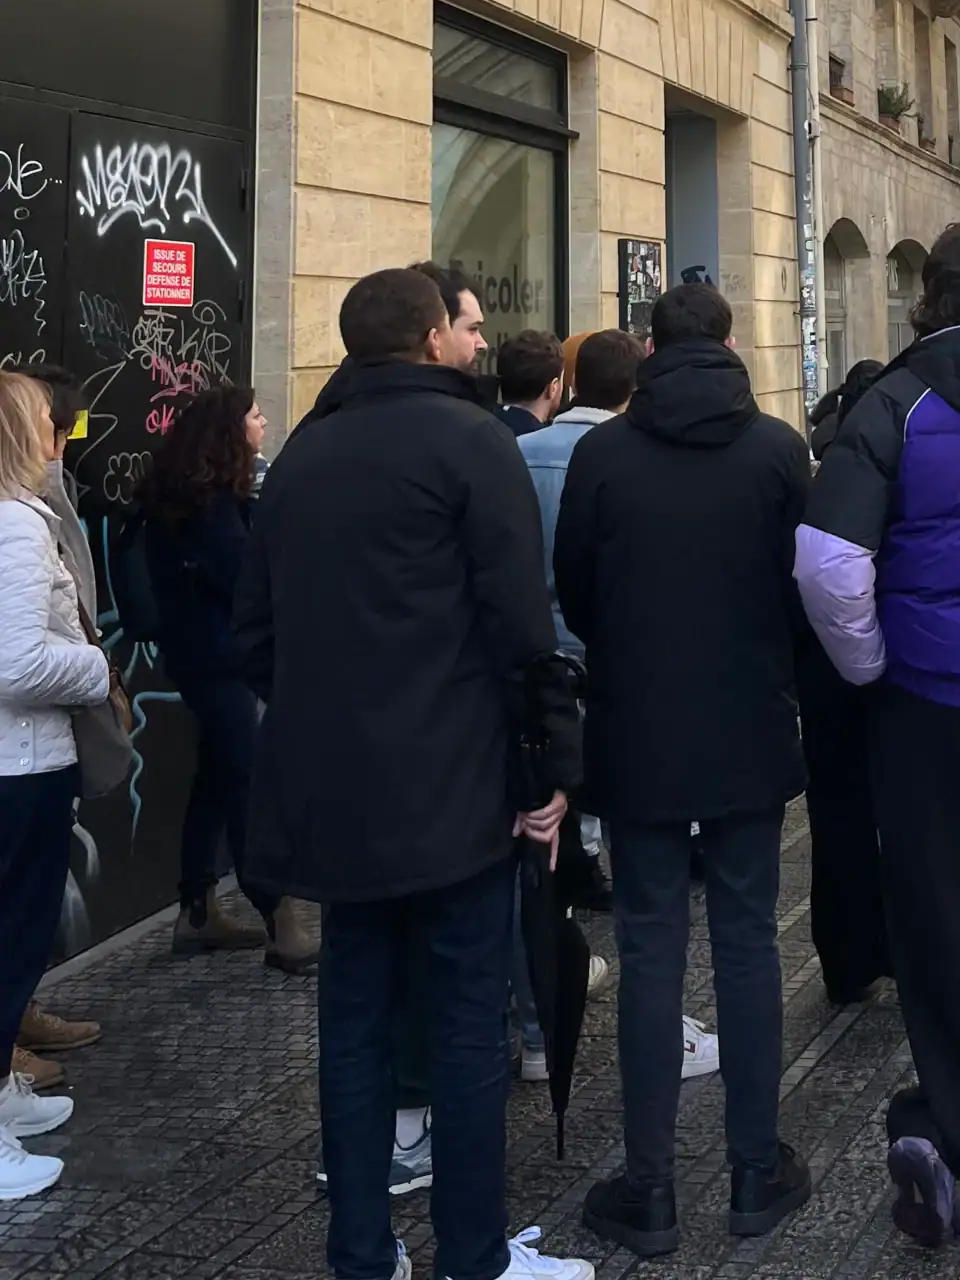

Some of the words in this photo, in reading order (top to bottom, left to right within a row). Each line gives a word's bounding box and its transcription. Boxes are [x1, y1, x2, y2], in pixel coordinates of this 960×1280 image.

[154, 248, 175, 261] ISSUE
[176, 250, 187, 262] DE
[152, 261, 187, 275] SECOURS
[147, 274, 179, 286] DEFENSE
[180, 276, 191, 287] DE
[146, 286, 191, 299] STATIONNER
